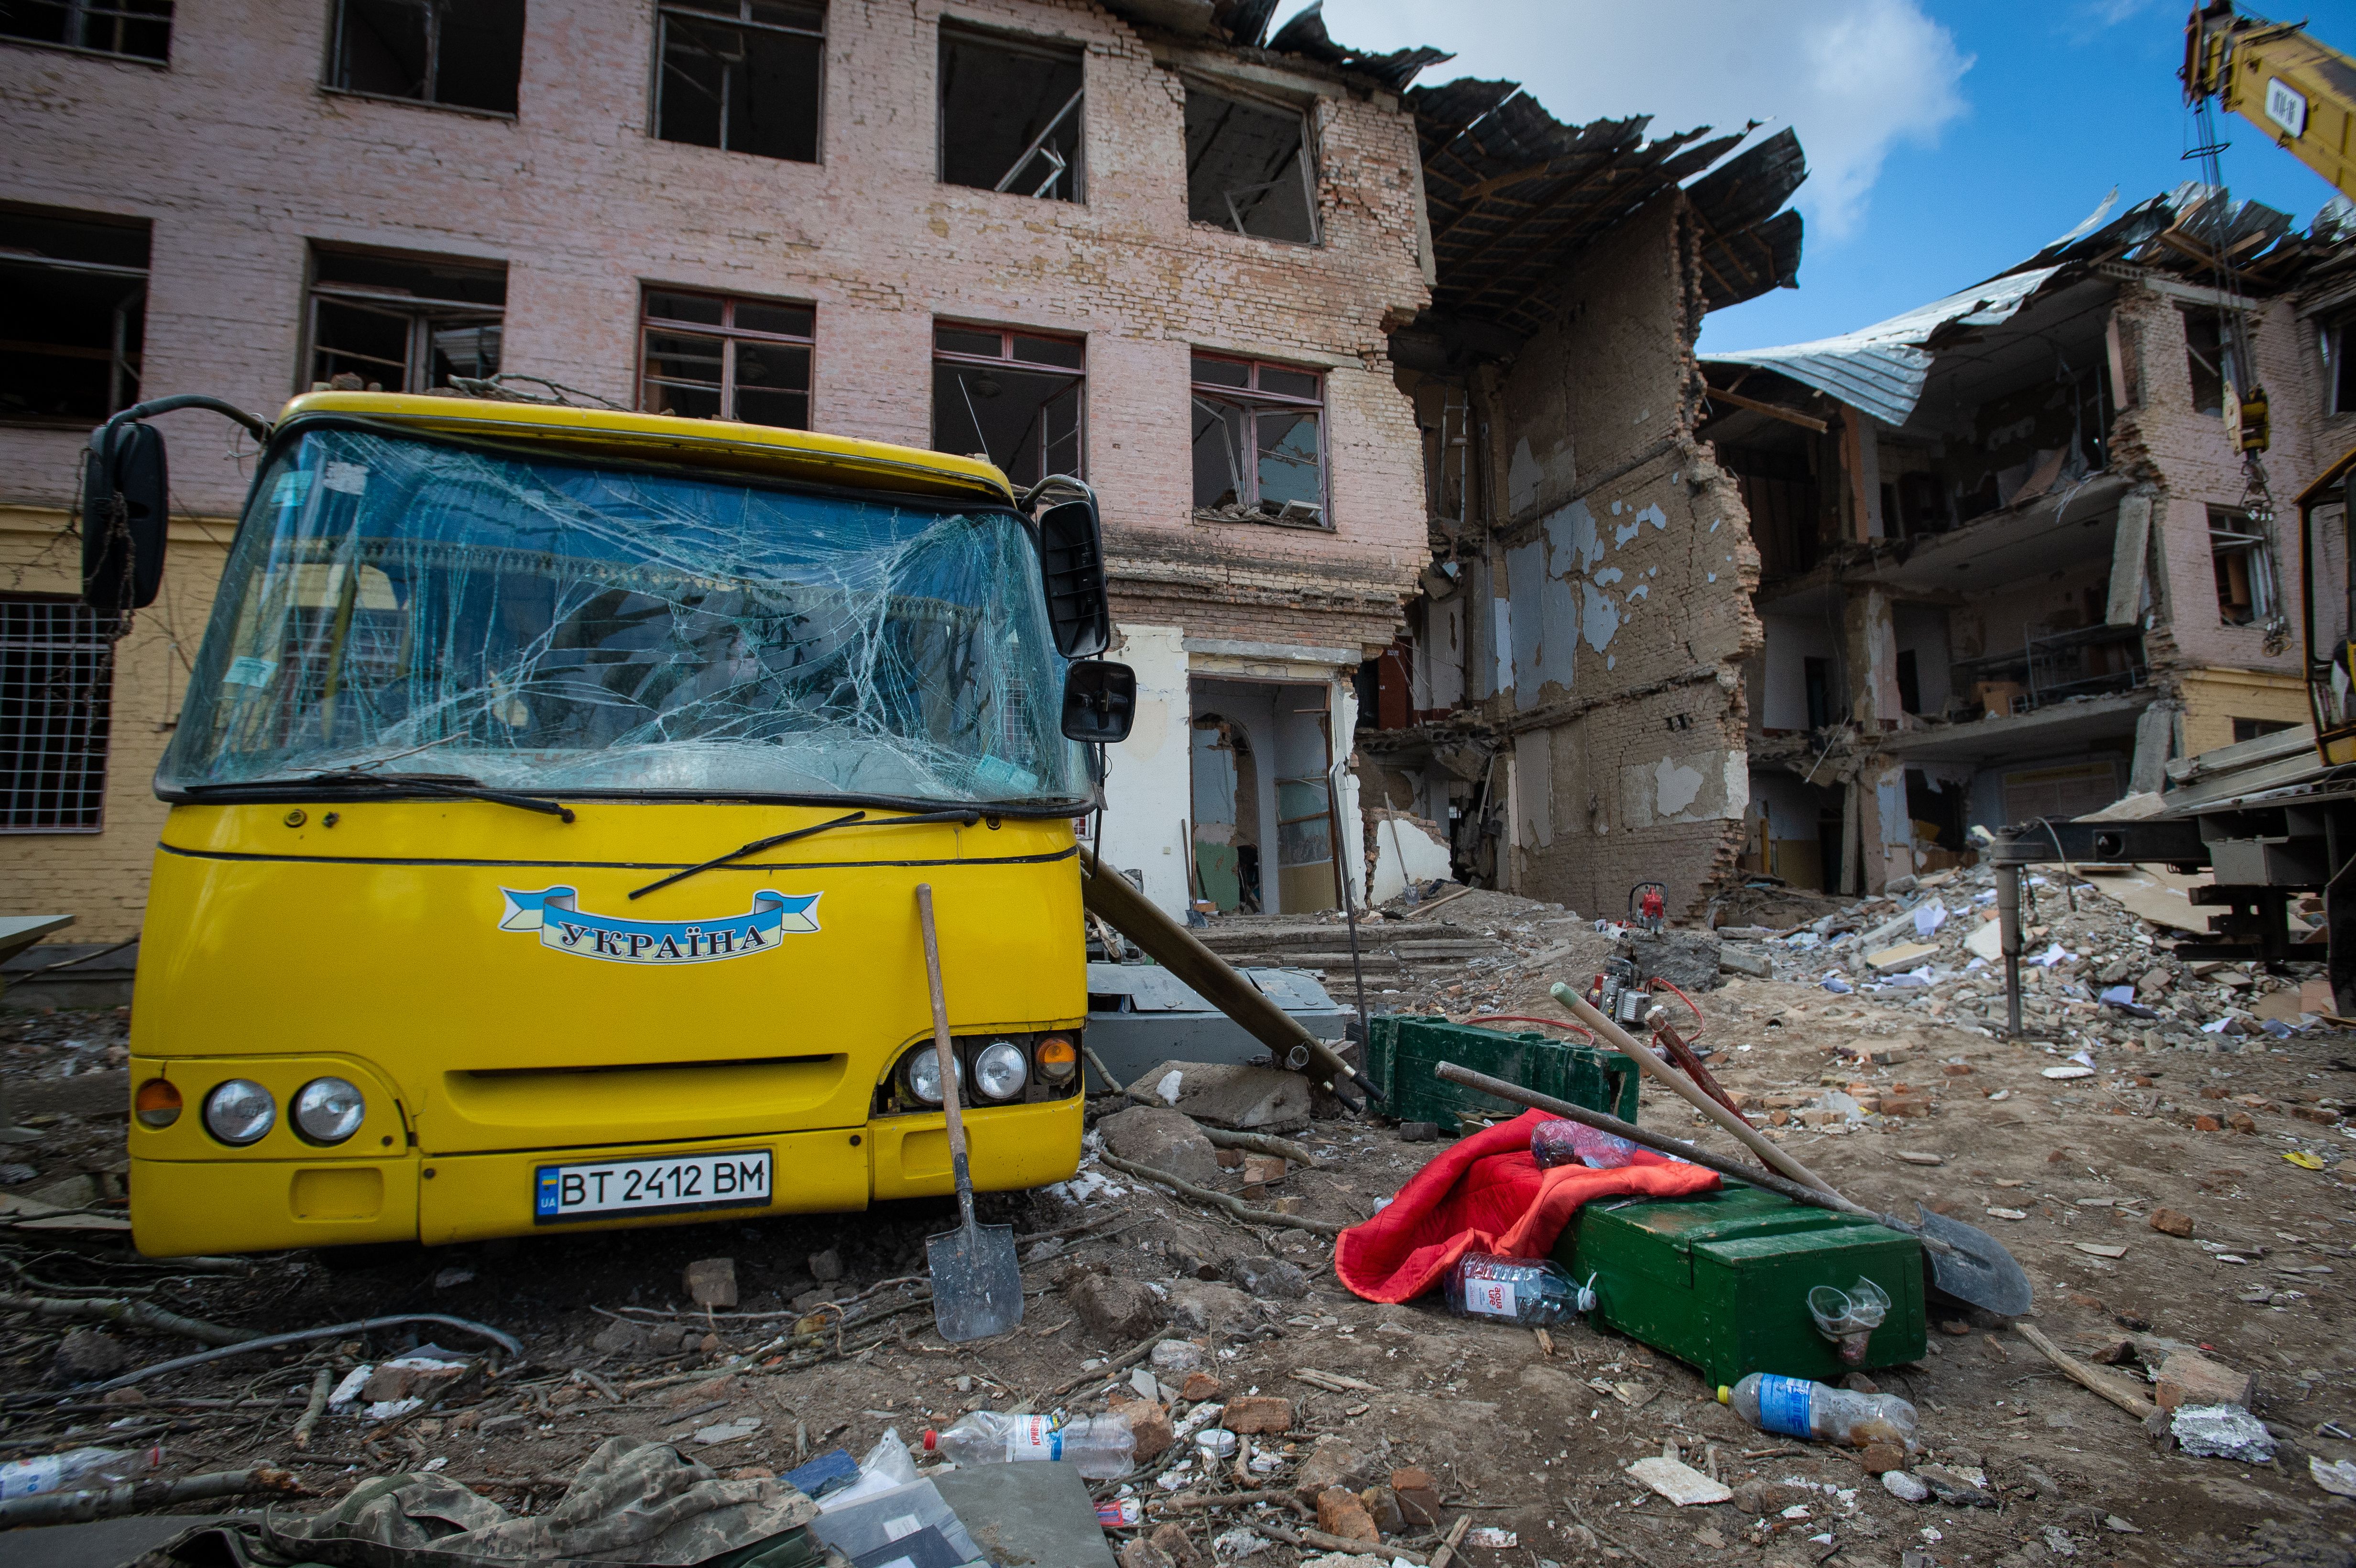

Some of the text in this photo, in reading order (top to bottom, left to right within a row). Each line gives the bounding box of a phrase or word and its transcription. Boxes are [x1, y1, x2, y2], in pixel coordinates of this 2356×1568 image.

[559, 922, 767, 959] УКРАЇНА
[562, 1160, 764, 1206] BT 2412 BM
[541, 1197, 557, 1208] UA
